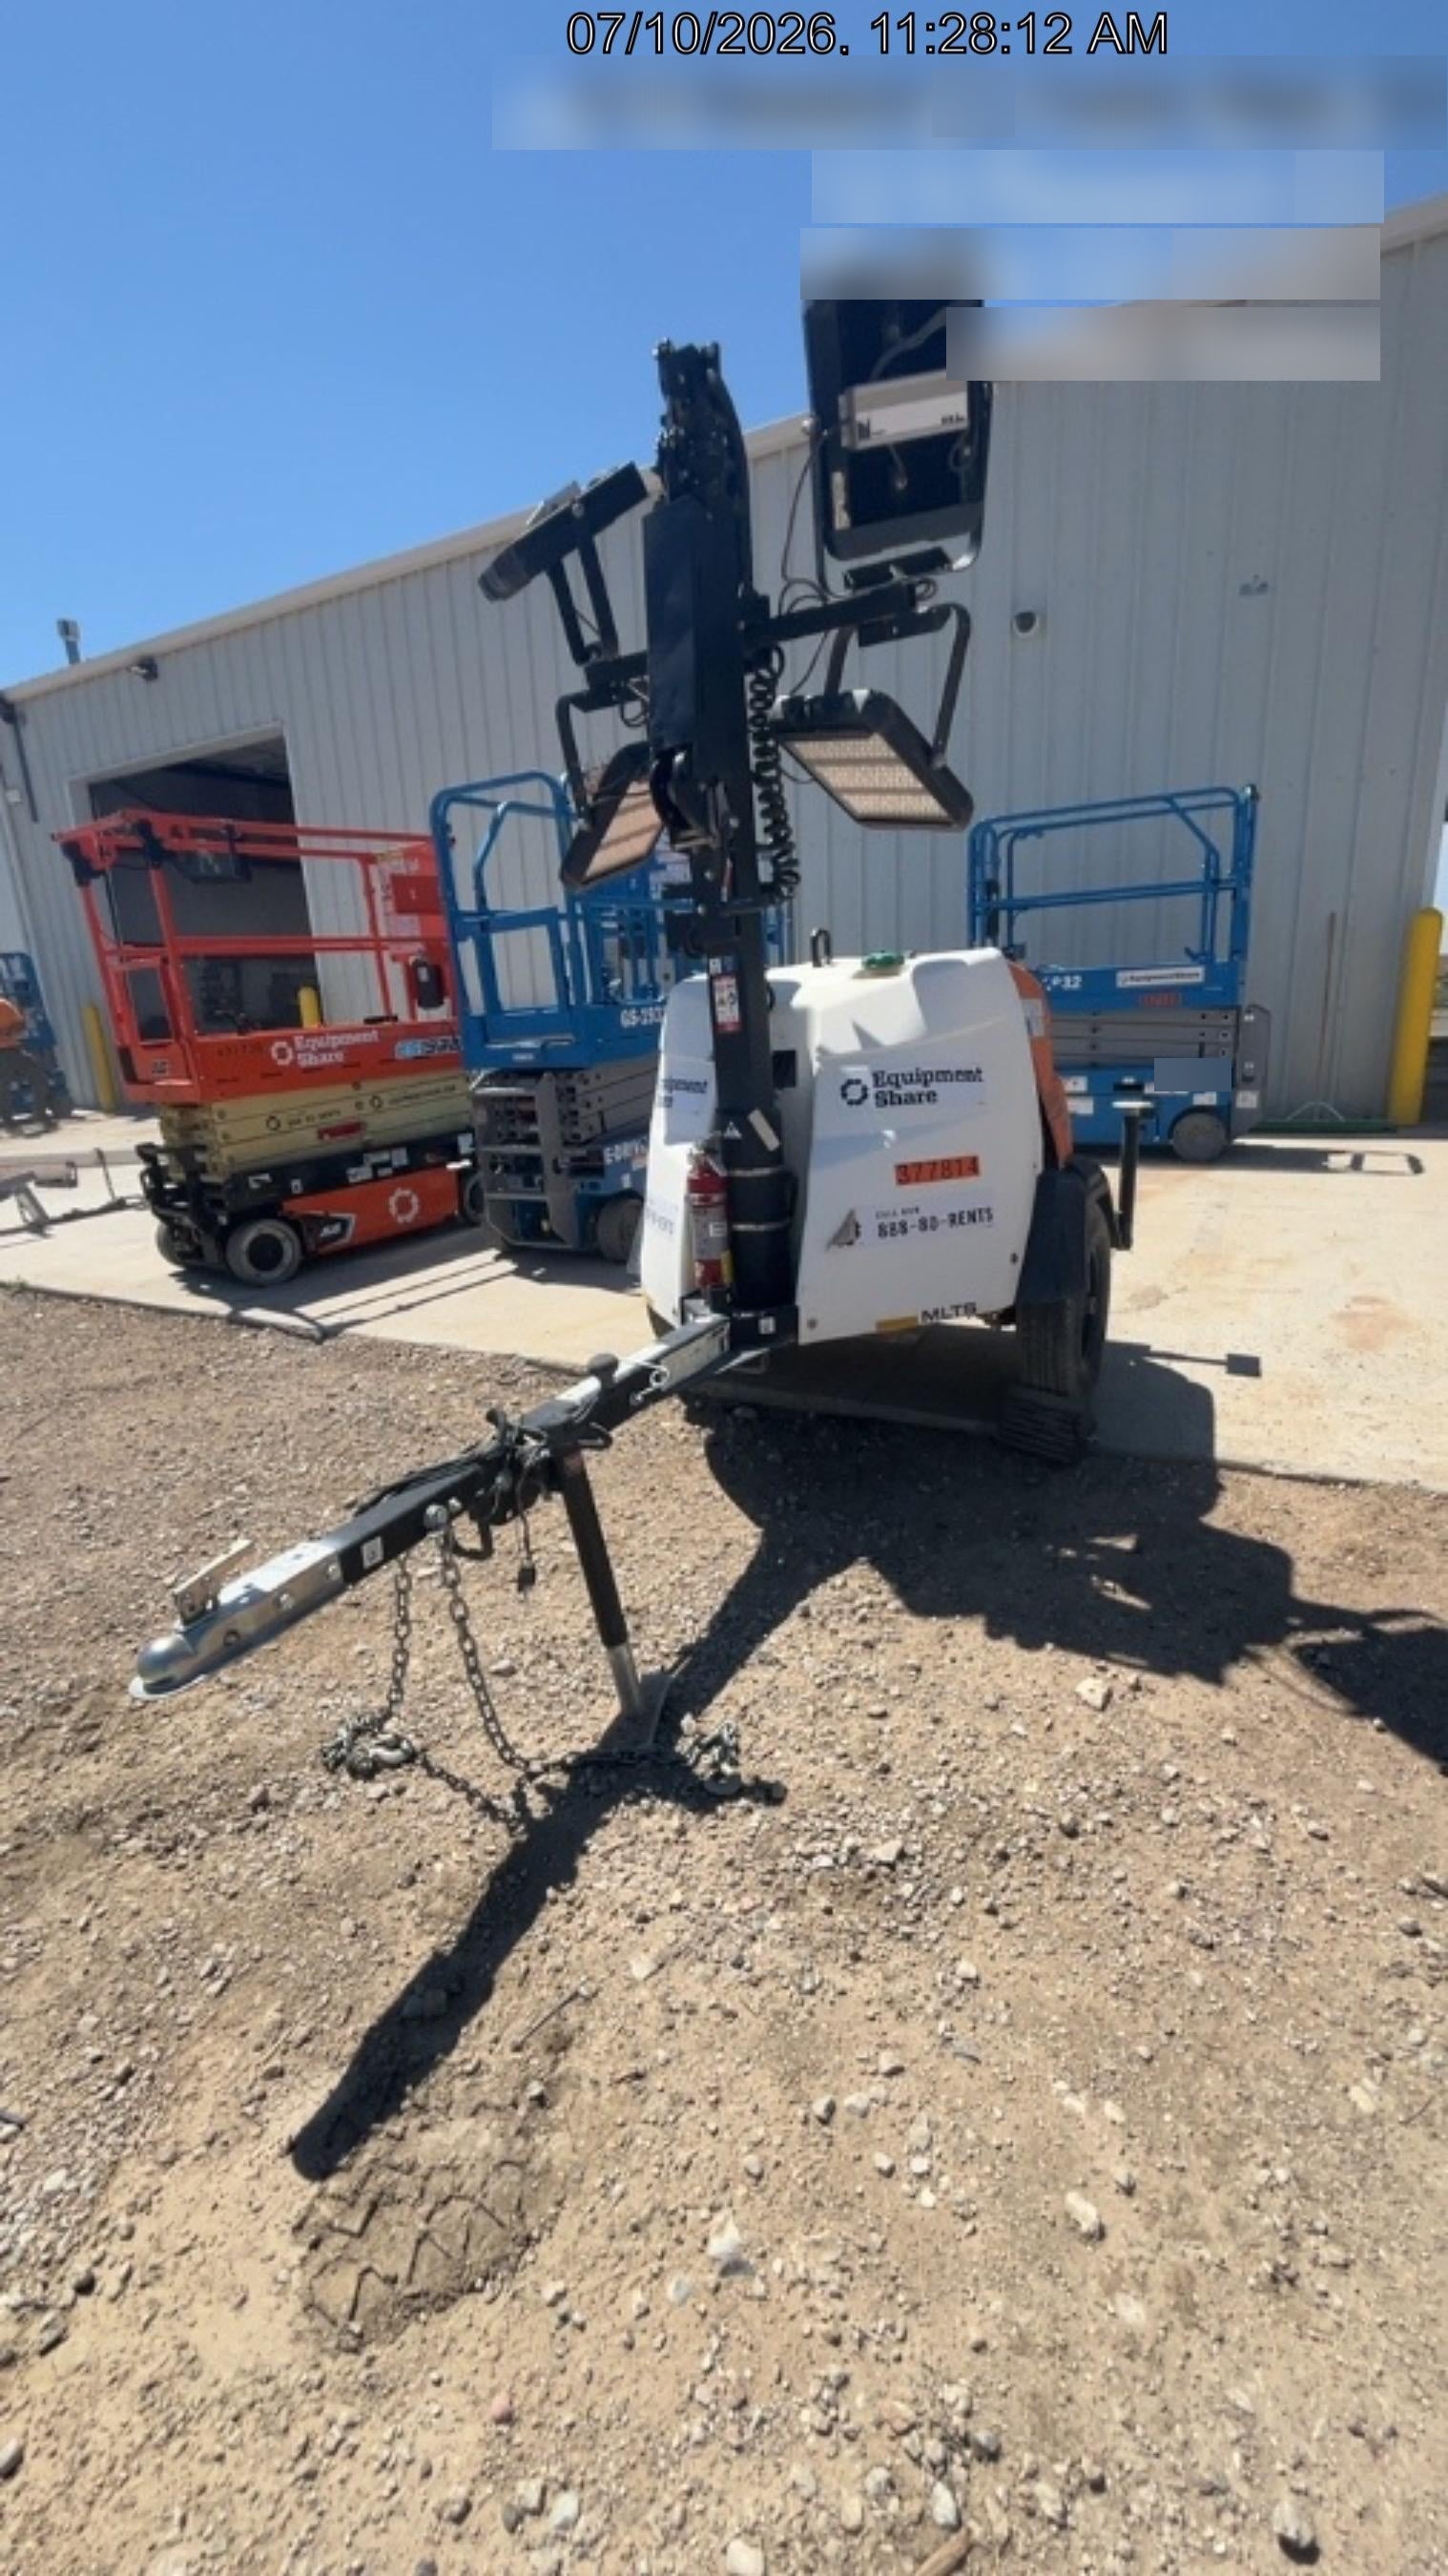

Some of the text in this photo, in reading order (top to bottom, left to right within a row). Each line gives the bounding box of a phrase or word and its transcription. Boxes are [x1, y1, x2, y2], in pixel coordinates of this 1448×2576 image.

[293, 1029, 380, 1052] Equipment
[297, 1049, 345, 1068] Share
[872, 1067, 983, 1090] Equipment
[875, 1090, 938, 1109] Share
[895, 1155, 980, 1185] 377814
